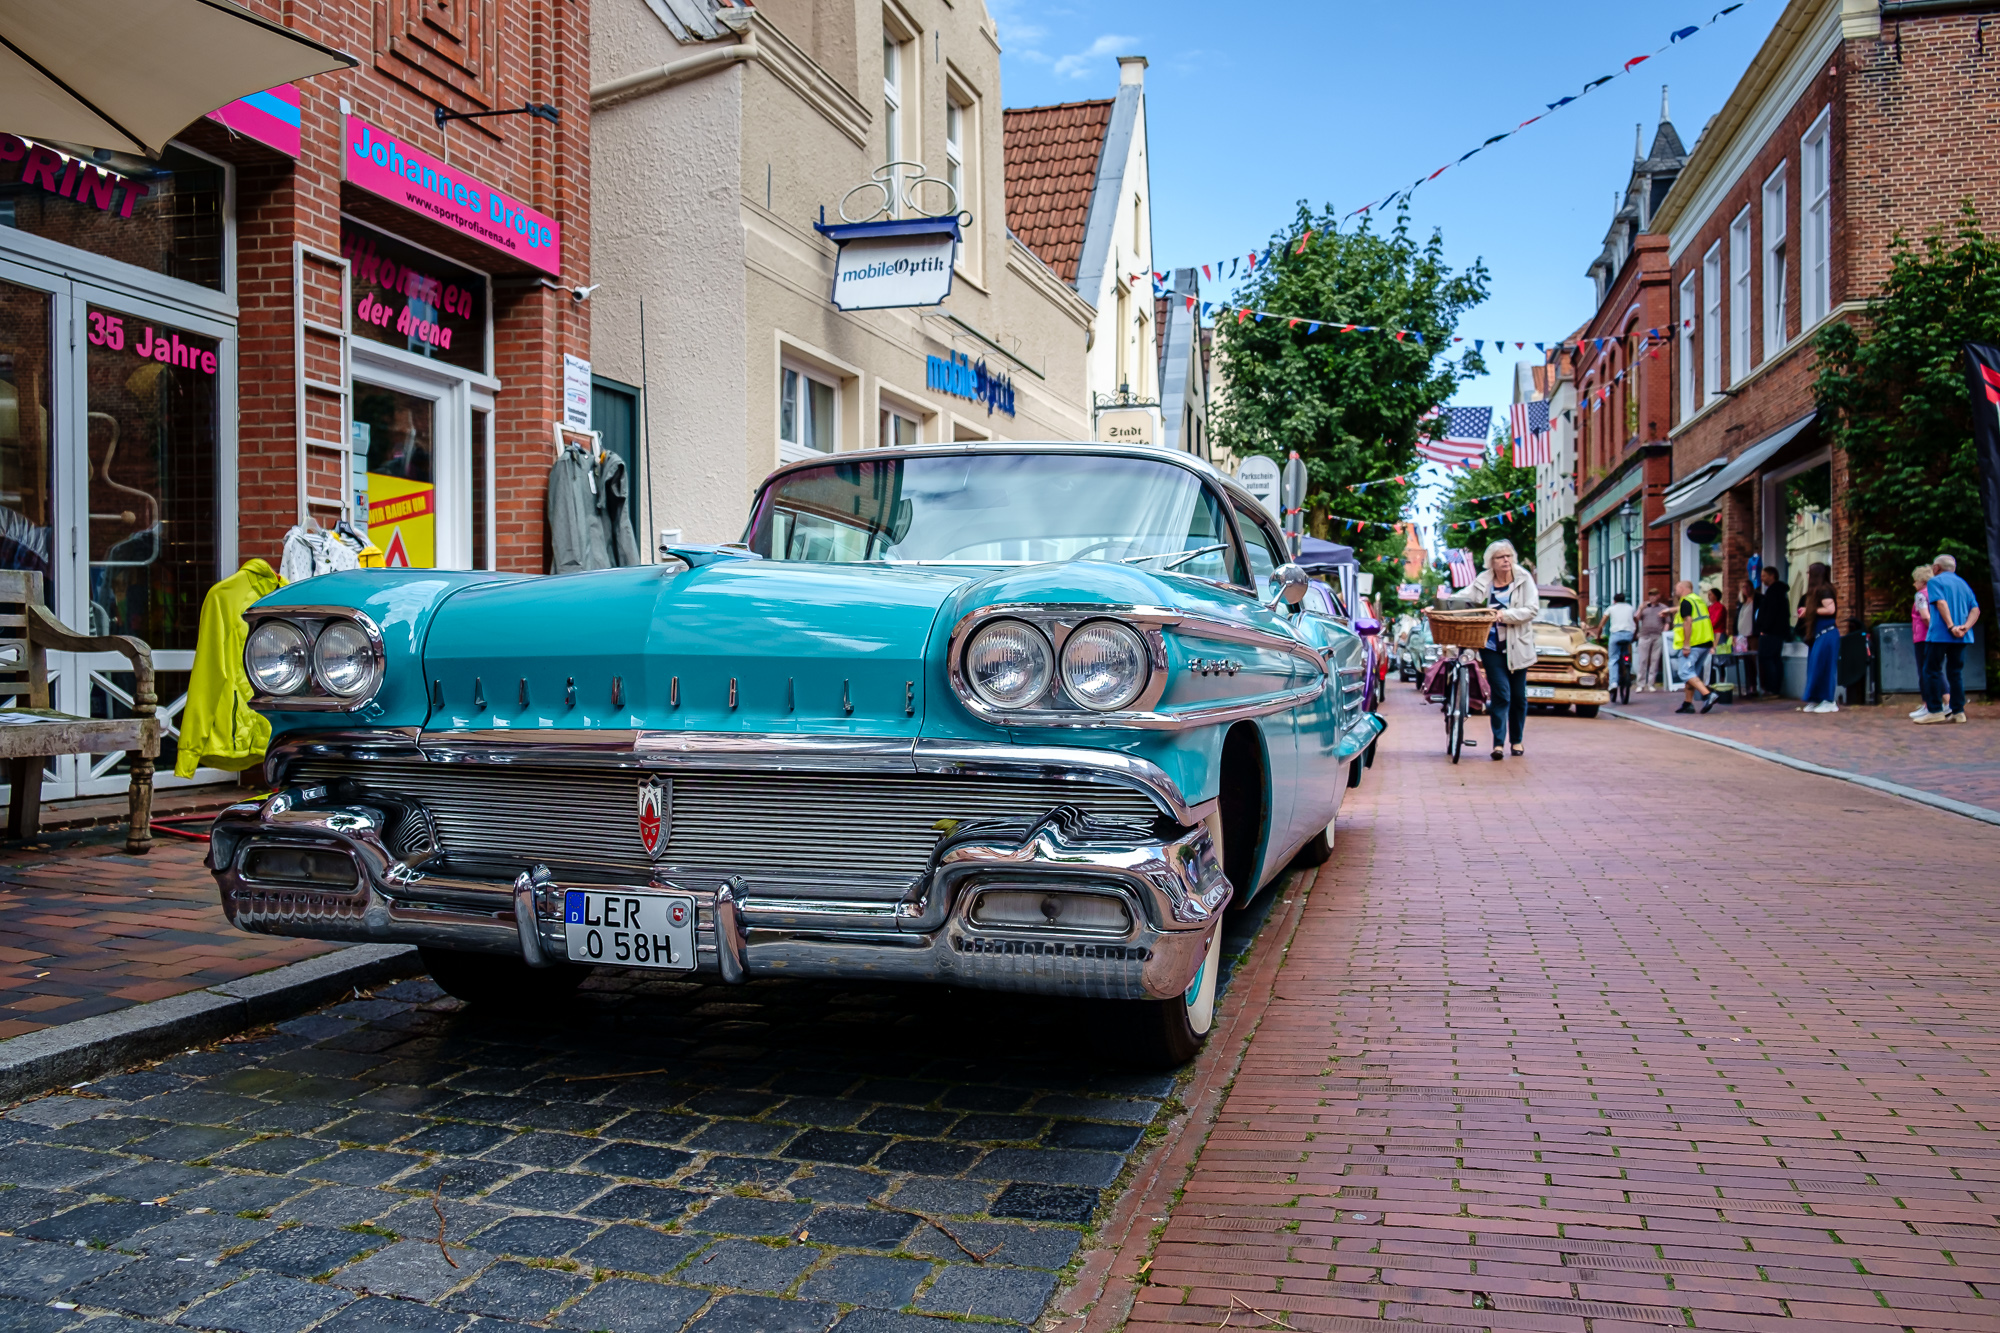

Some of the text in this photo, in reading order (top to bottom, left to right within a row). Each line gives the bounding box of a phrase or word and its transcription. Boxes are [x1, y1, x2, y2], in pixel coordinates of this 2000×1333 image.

[353, 128, 552, 248] Johannes Dröge
[405, 191, 516, 250] www.sportprofiarena.de
[842, 256, 944, 282] mobileOptik
[357, 292, 452, 350] der Arena
[88, 312, 217, 374] 35 Jahre
[926, 349, 1015, 418] mobileOptik
[1109, 426, 1142, 437] Stadt
[1241, 472, 1275, 480] Parkschein-
[368, 506, 385, 525] WIR
[384, 499, 412, 520] BAUEN
[412, 495, 426, 512] UM
[571, 911, 579, 922] D
[584, 895, 641, 929] LER
[614, 931, 672, 964] 58H
